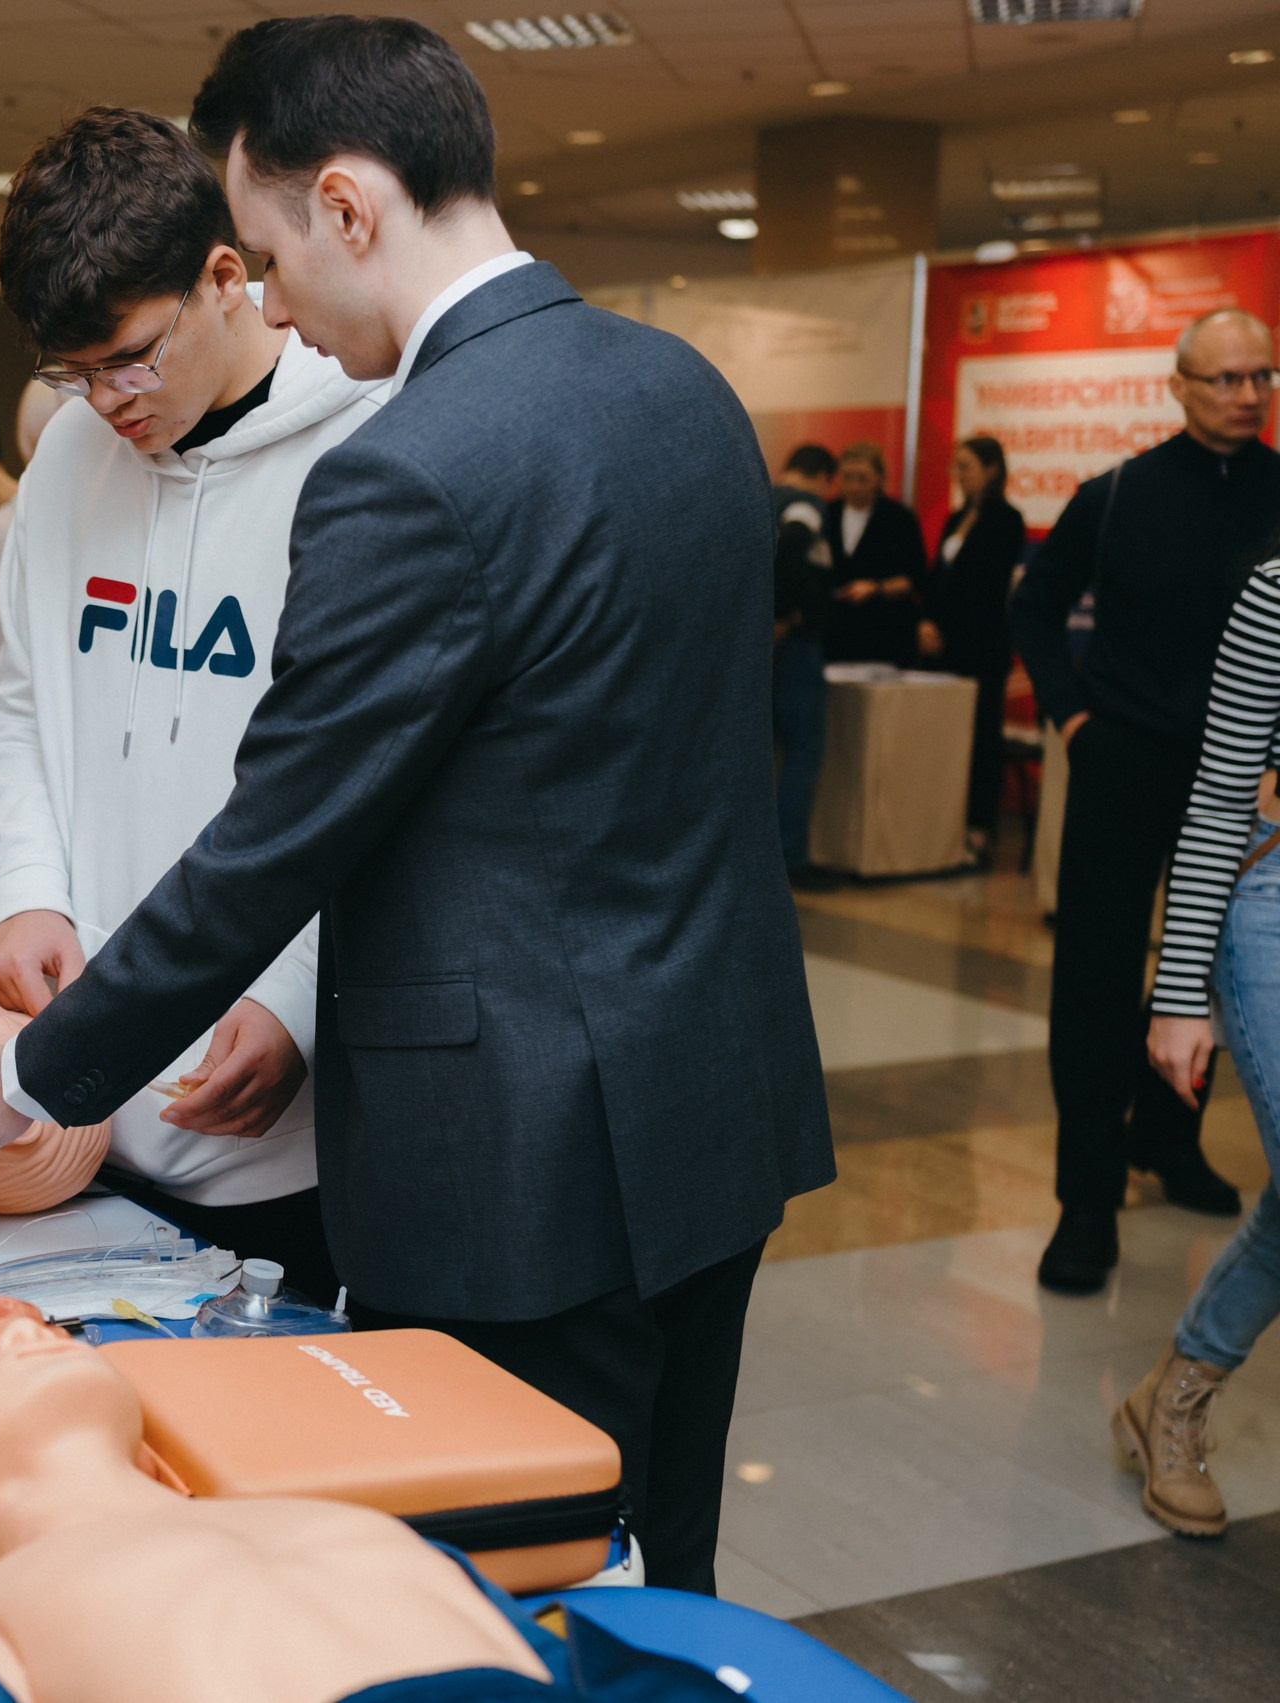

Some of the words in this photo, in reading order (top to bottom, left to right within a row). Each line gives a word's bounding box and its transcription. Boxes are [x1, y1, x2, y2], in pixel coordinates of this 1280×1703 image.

[78, 576, 256, 678] FILA
[297, 1345, 372, 1387] TRAINER
[362, 1388, 410, 1418] AED
